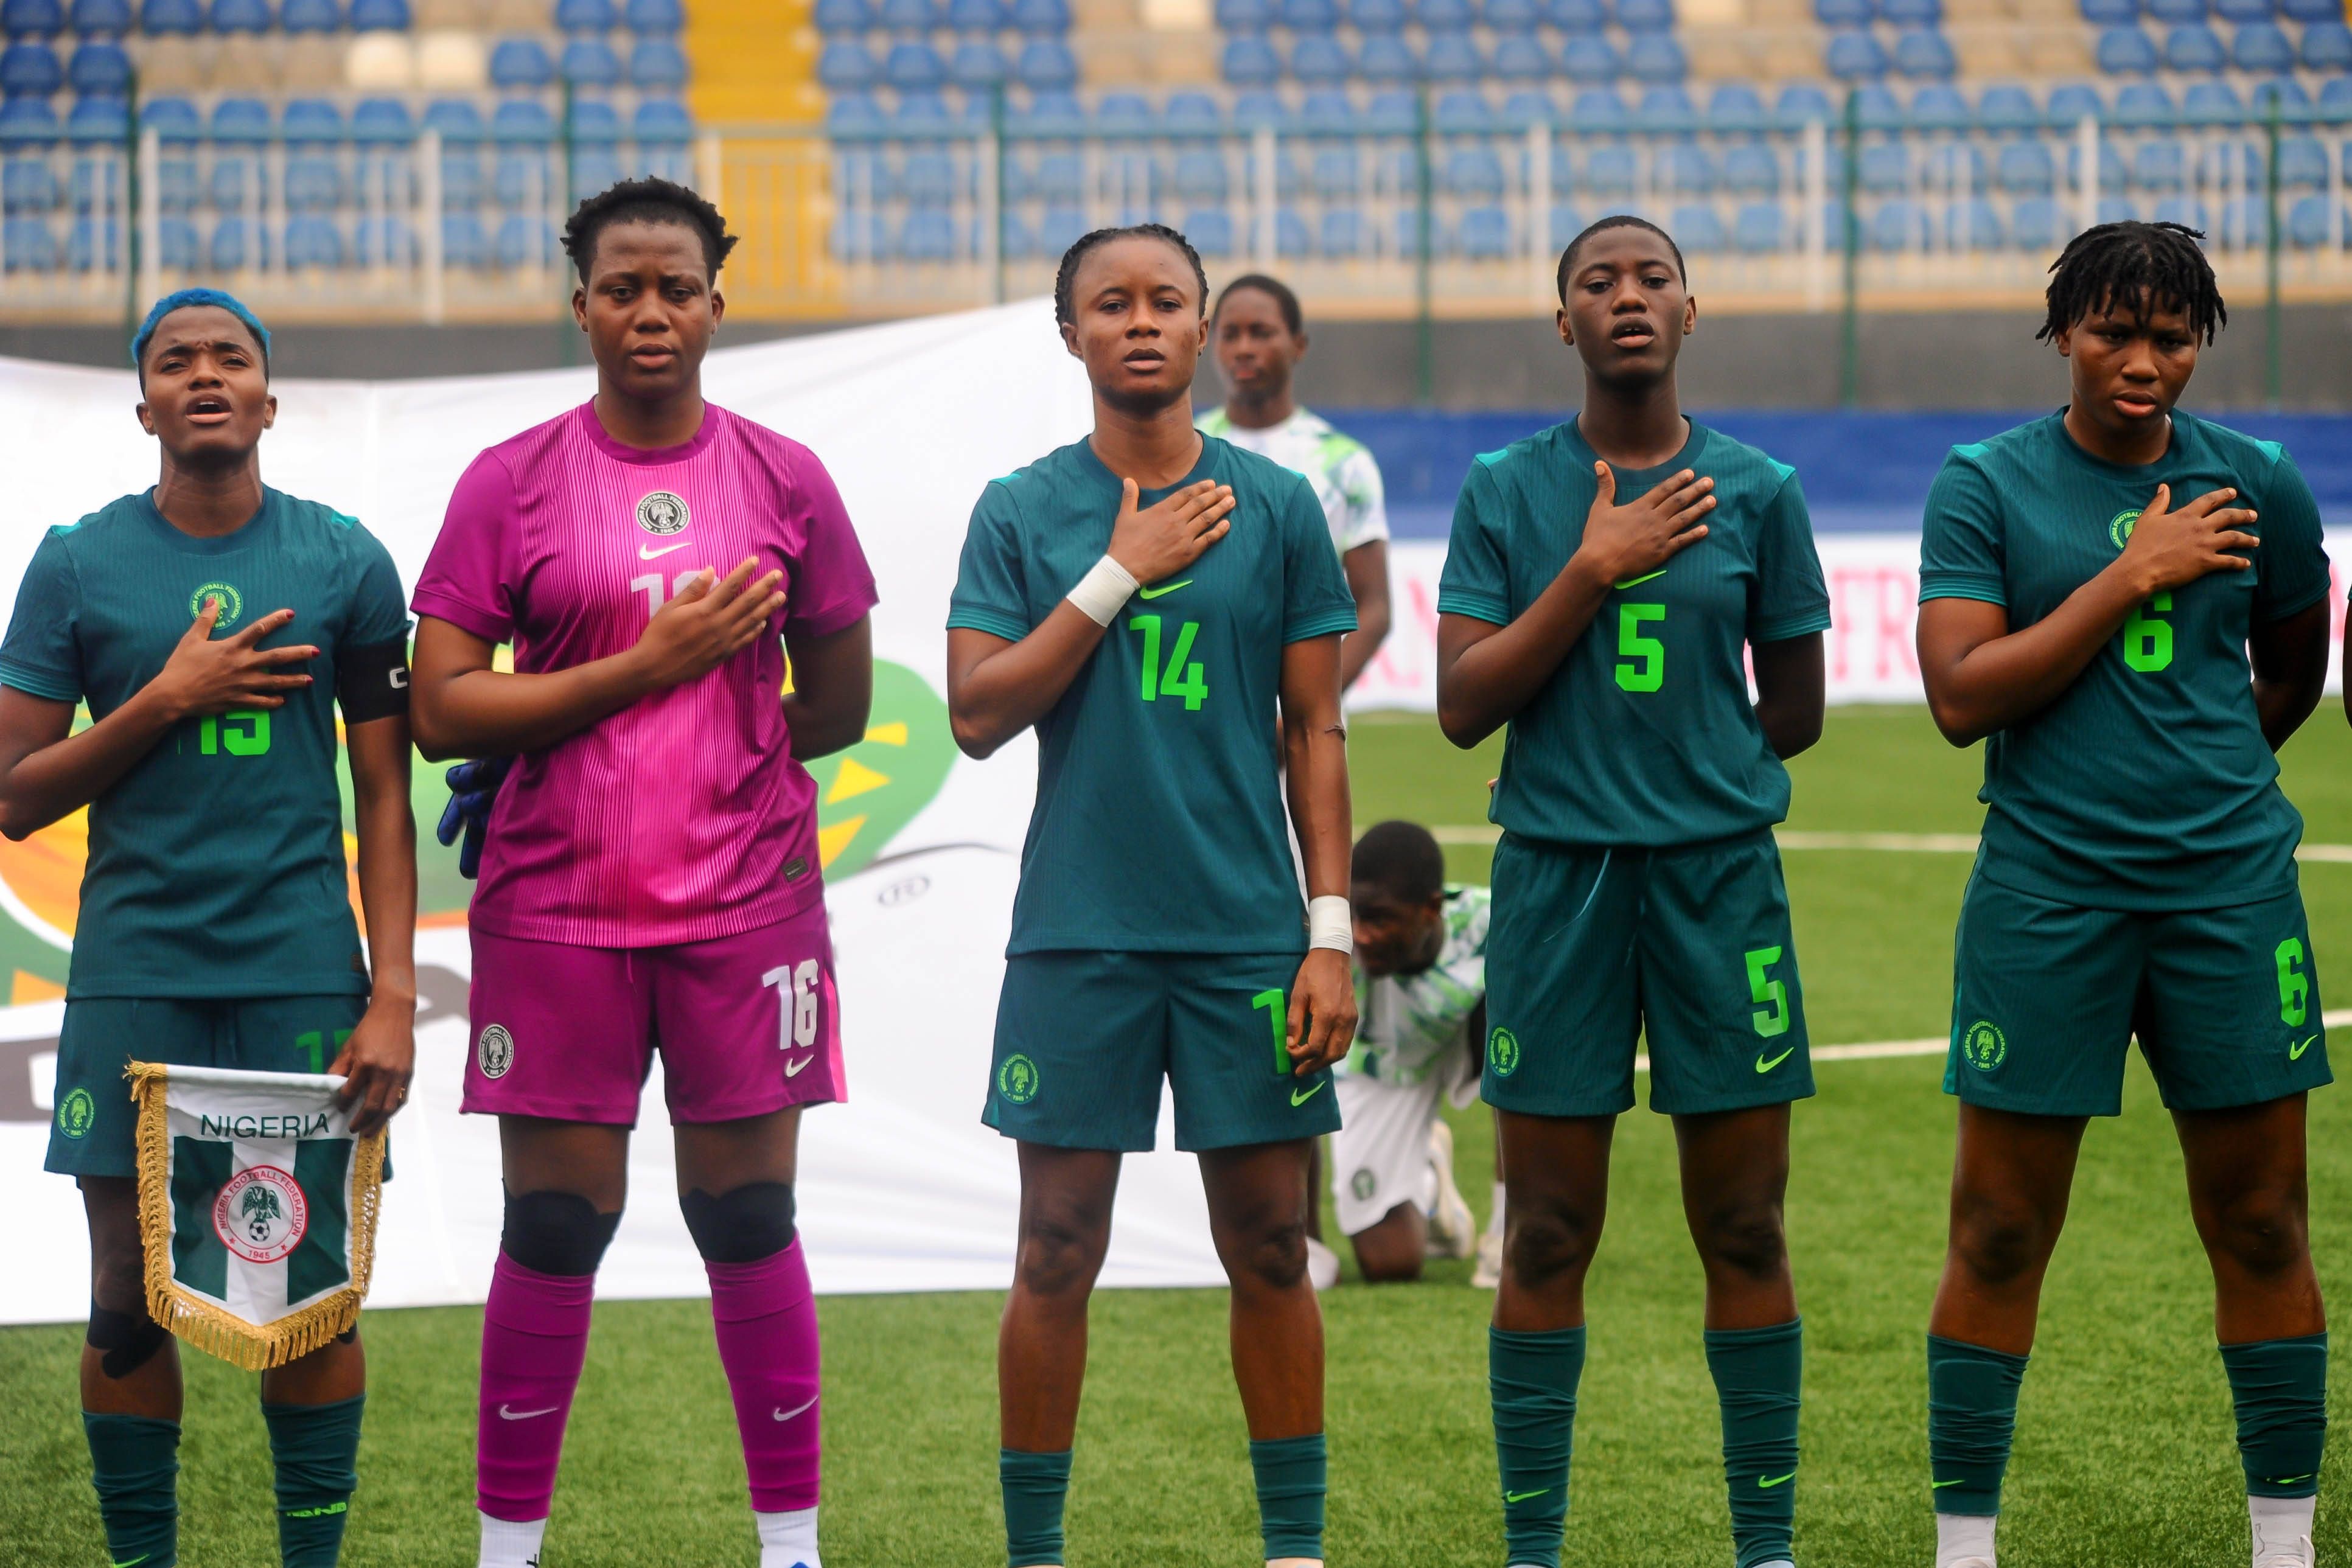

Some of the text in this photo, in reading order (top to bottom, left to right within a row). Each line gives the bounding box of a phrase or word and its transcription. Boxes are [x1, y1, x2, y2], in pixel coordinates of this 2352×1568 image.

[640, 493, 669, 510] FOOTBALL
[2112, 527, 2125, 548] NIGERIA
[195, 584, 225, 600] FOOTBALL
[225, 585, 241, 619] FEDERATION
[630, 570, 721, 622] 1
[1616, 604, 1666, 692] 5
[2124, 590, 2172, 672] 6
[389, 667, 408, 689] C
[1129, 615, 1208, 711] 14
[762, 958, 818, 1050] 16
[1745, 945, 1789, 1037] 5
[2275, 937, 2308, 1027] 6
[295, 1028, 355, 1073] 1
[1964, 1021, 2005, 1064] NIGERIA FOOTBALL FEDERATION
[200, 1112, 330, 1139] NIGERIA
[217, 1171, 305, 1237] NIGERIA FOOTBALL FEDERATION
[248, 1249, 271, 1260] 1945
